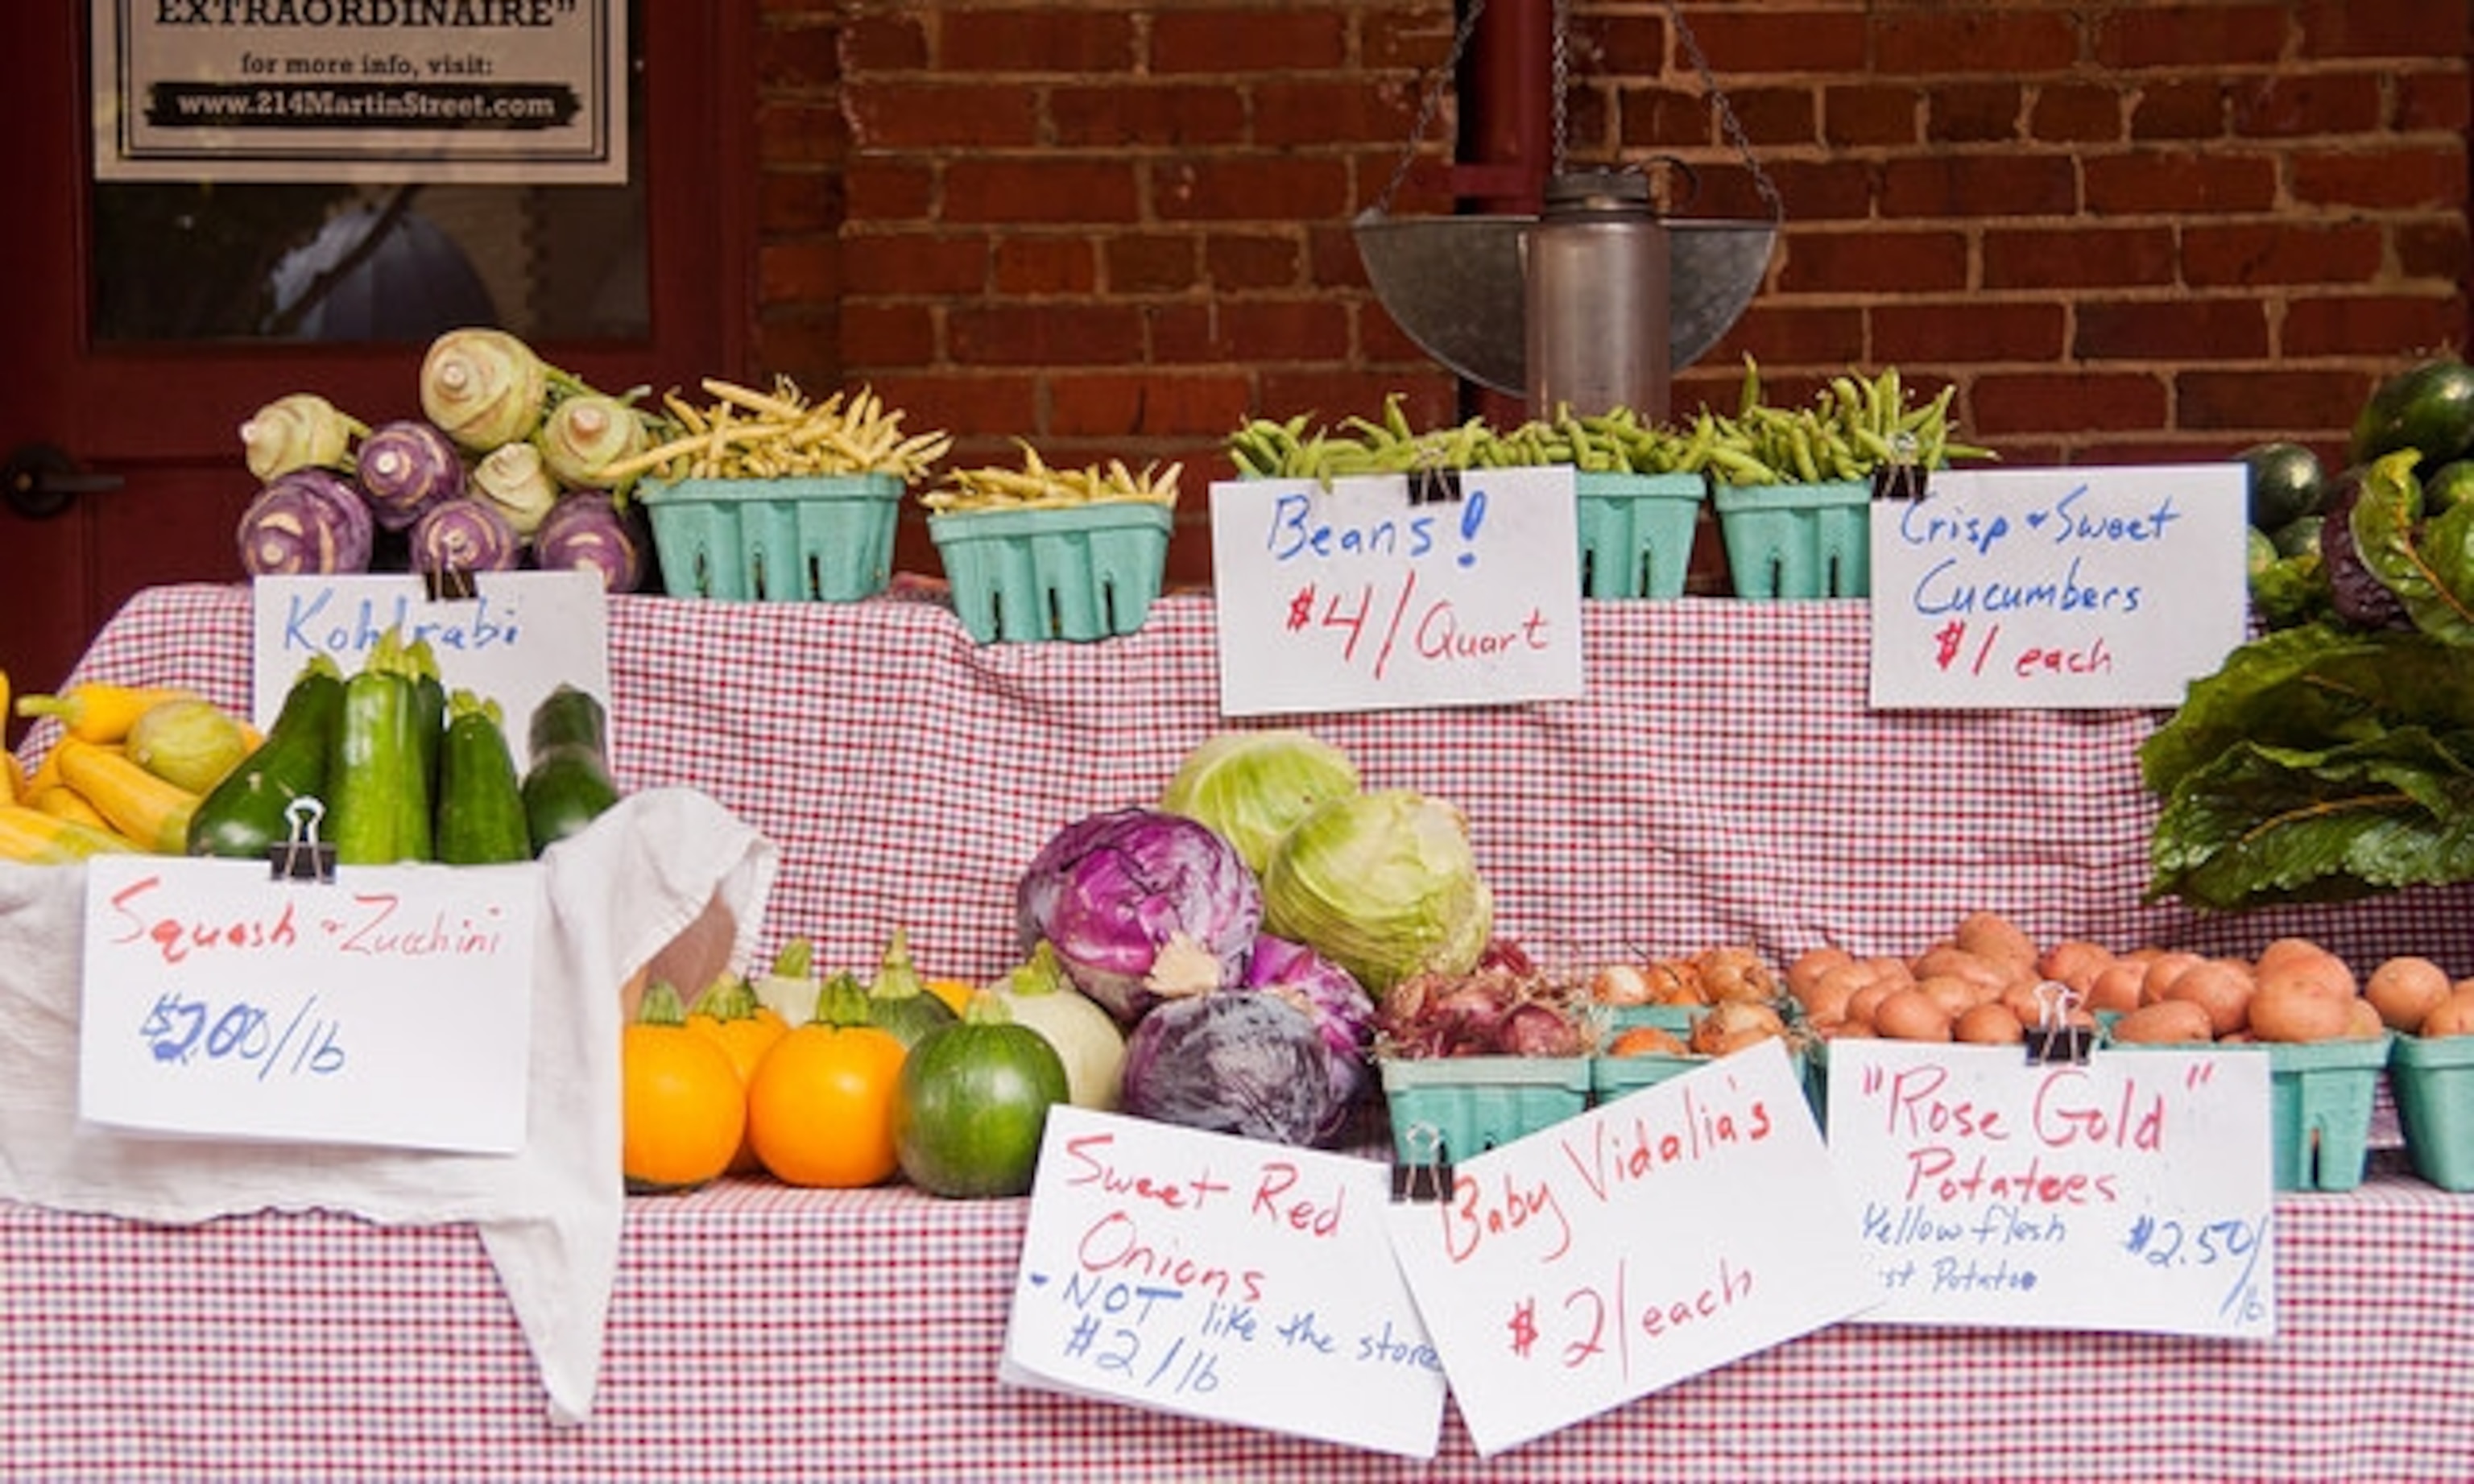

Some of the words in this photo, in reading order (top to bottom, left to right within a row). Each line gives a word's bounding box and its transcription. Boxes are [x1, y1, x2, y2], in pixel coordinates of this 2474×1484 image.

[241, 51, 278, 74] for
[285, 56, 354, 74] more
[362, 53, 419, 78] info,
[428, 53, 493, 75] visit:
[176, 89, 556, 118] www.214MartinStreet.com
[1901, 491, 2011, 556] Crisp
[2055, 482, 2181, 544] Sweet
[1913, 556, 2141, 615] Cucumbers
[2015, 638, 2112, 676] each
[111, 875, 299, 964] Squash
[339, 893, 501, 957] Zucchini
[1065, 1133, 1231, 1209] Sweet
[1252, 1162, 1346, 1238] Red
[1442, 1173, 1571, 1263] Baby
[1562, 1075, 1772, 1202] Vidalia's
[1905, 1146, 2118, 1205] Potatoes
[1078, 1210, 1267, 1303] Onions
[1863, 1202, 1963, 1246] Yellow
[1971, 1203, 2068, 1246] flesh
[1063, 1271, 1184, 1326] NOT
[1202, 1300, 1258, 1342] like
[1276, 1311, 1337, 1354] the
